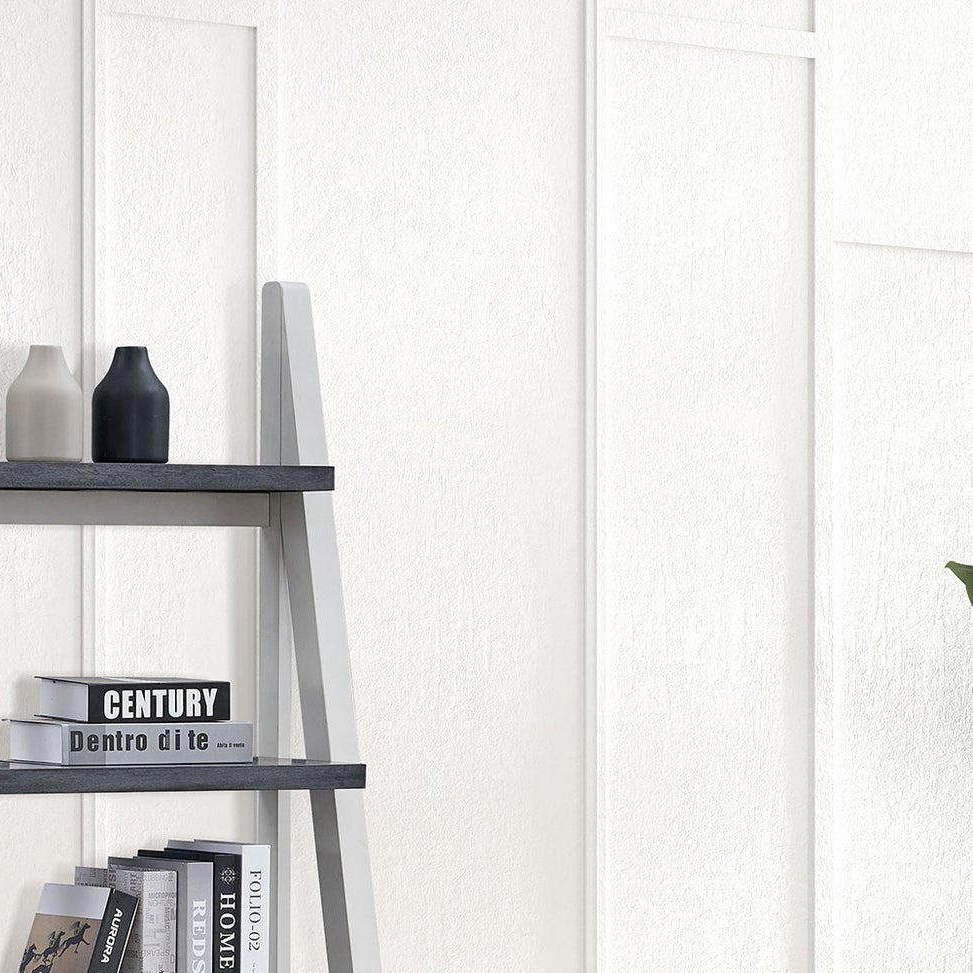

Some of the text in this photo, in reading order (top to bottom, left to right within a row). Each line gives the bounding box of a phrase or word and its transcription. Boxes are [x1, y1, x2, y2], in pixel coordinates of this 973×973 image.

[103, 688, 218, 719] CENTURY
[70, 730, 148, 752] Dentro
[187, 730, 209, 751] te
[100, 907, 124, 964] AURORA
[219, 892, 236, 970] HOME
[248, 870, 262, 952] FOLIO-02
